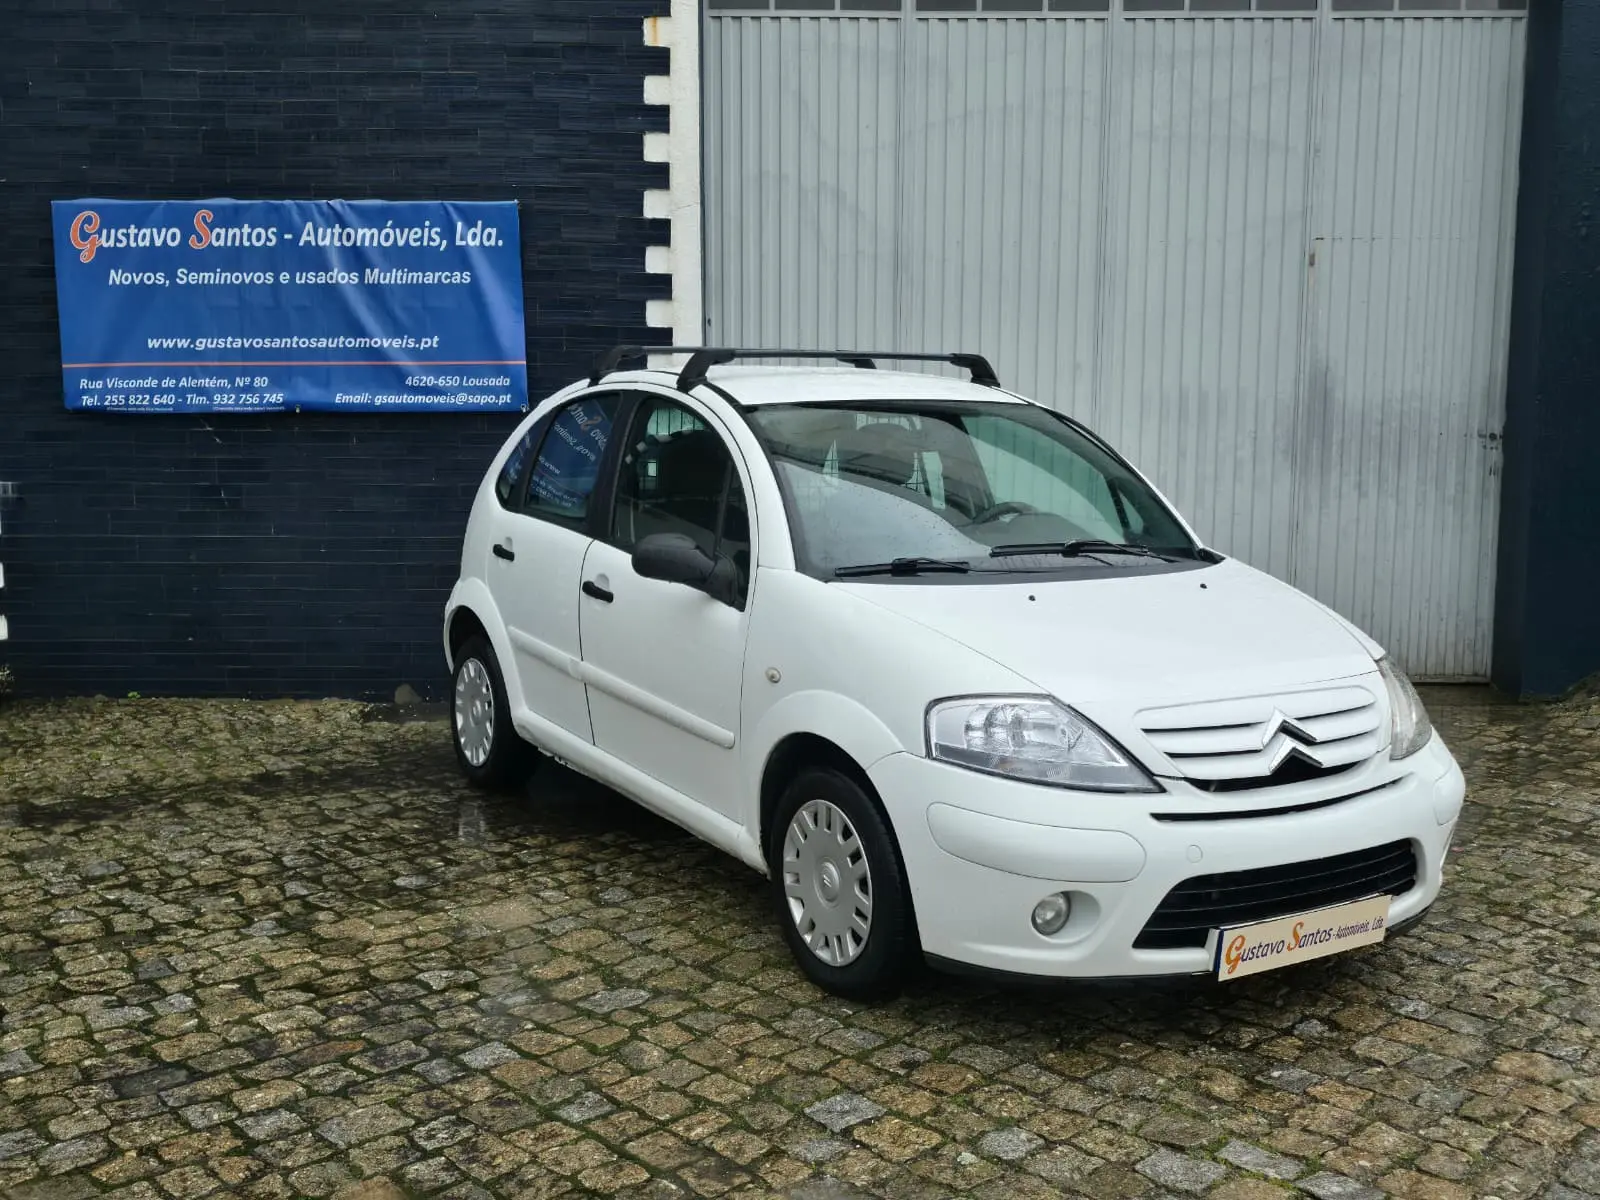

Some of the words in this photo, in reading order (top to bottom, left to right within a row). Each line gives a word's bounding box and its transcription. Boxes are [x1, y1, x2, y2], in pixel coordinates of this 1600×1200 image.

[70, 210, 181, 263] Gustavo
[189, 210, 277, 249] Santos
[299, 220, 448, 251] Automóveis,
[455, 220, 504, 247] Lda.
[108, 268, 170, 287] Novos,
[175, 268, 274, 285] Seminovos
[279, 271, 290, 285] e
[295, 268, 359, 285] usados
[364, 268, 472, 285] Multimarcas
[147, 335, 439, 351] www.gustavosantosautomoveis.pt
[80, 378, 103, 390] Rua
[106, 377, 158, 389] Visconde
[163, 377, 176, 388] de
[178, 376, 232, 390] Alentém,
[253, 376, 269, 388] 80
[405, 375, 460, 386] 4620-650
[463, 375, 510, 386] Lousada
[81, 395, 101, 407] Tel.
[104, 395, 125, 406] 255
[128, 394, 149, 405] 822
[152, 394, 175, 405] 640
[186, 394, 210, 405] Tlm.
[213, 393, 235, 405] 932
[238, 393, 260, 405] 756
[263, 393, 284, 404] 745
[335, 392, 372, 404] Email:
[374, 392, 512, 406] gsautomoveis@sapo.pt
[1225, 934, 1285, 975] Gustavo
[1287, 921, 1332, 952] Santos
